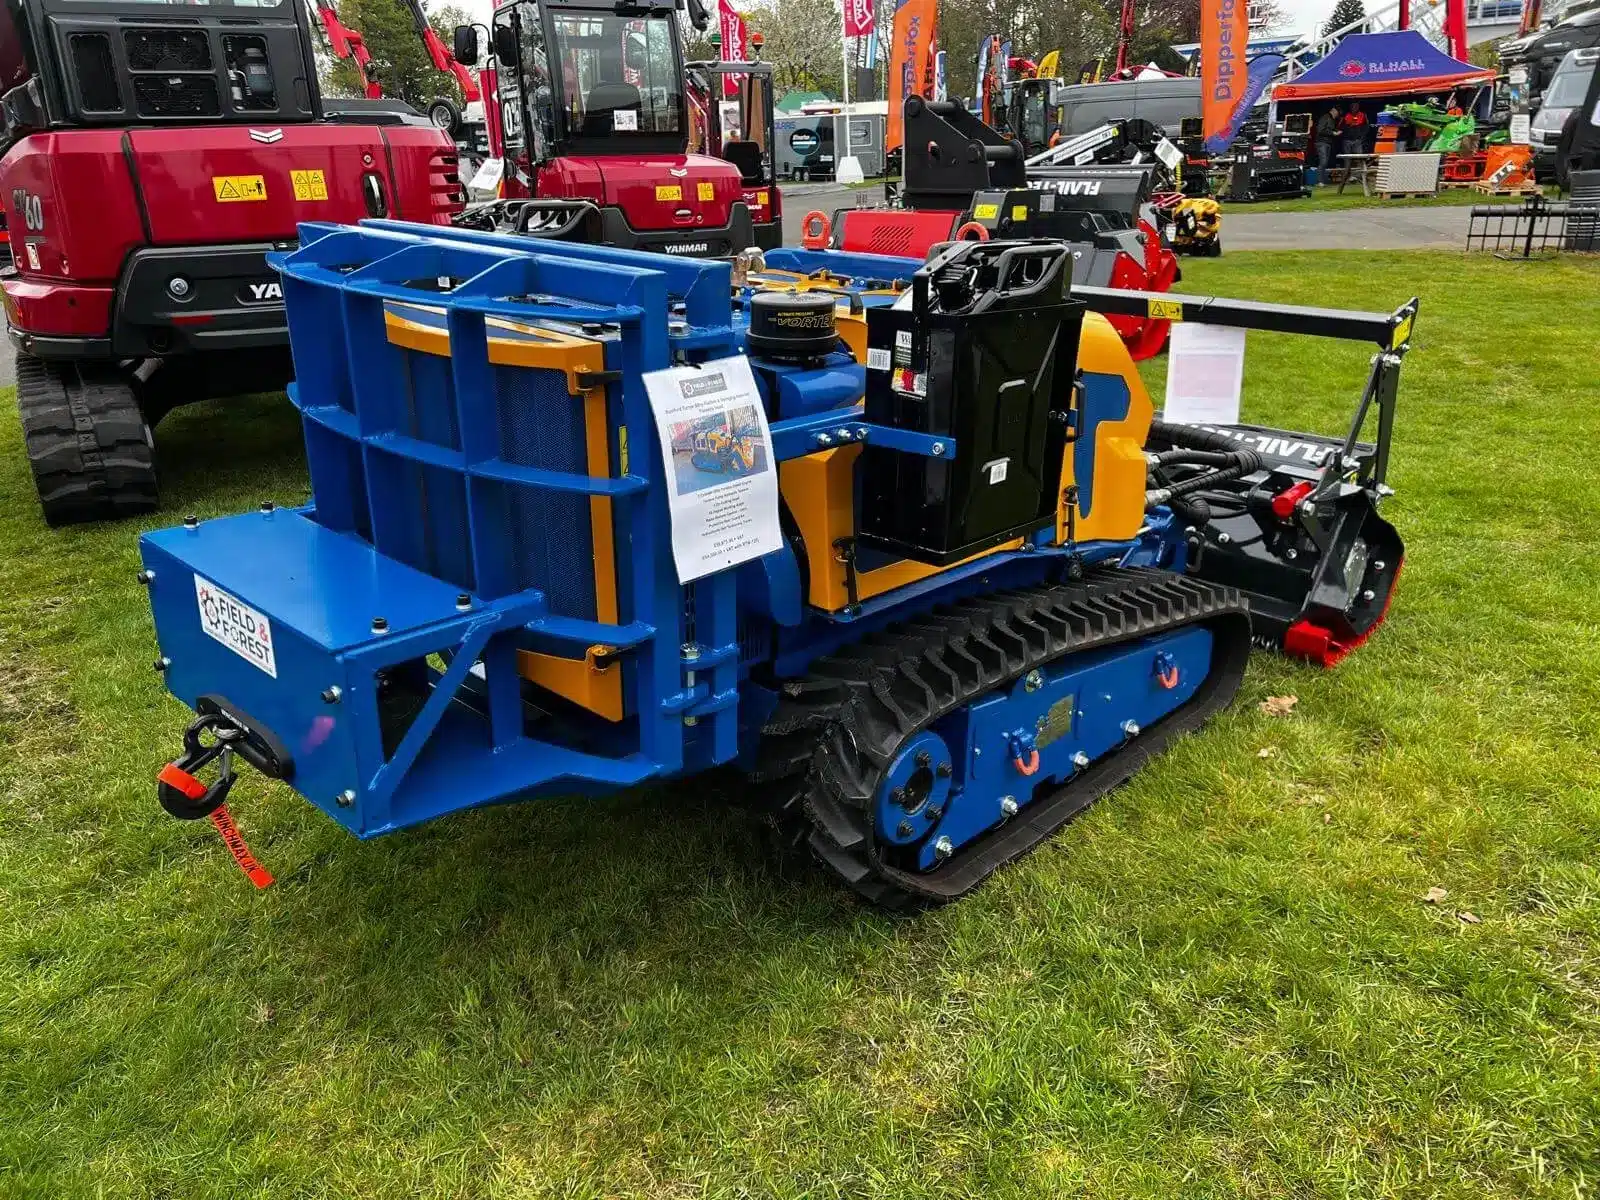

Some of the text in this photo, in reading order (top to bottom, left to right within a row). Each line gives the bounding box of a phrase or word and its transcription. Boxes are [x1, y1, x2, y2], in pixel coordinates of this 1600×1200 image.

[1215, 0, 1236, 100] Dipperfo
[664, 243, 708, 255] YANMAR
[249, 283, 283, 299] YA
[219, 597, 256, 635] FIELD
[259, 623, 269, 643] &
[222, 620, 270, 664] FOREST
